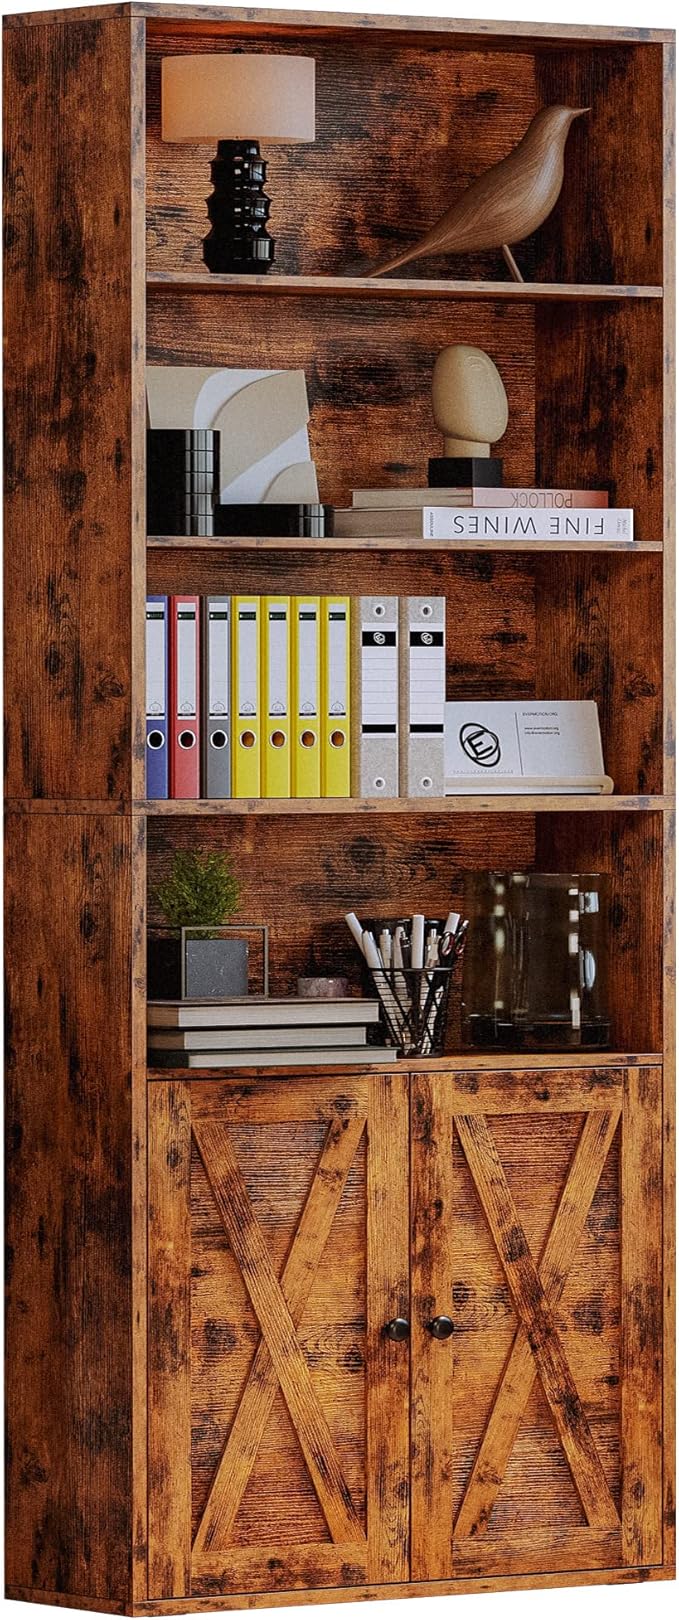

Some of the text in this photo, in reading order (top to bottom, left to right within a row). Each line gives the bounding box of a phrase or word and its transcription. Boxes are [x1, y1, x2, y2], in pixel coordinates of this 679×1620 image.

[511, 492, 573, 509] POLLOCK
[453, 515, 537, 534] WINES
[549, 516, 604, 535] FINE
